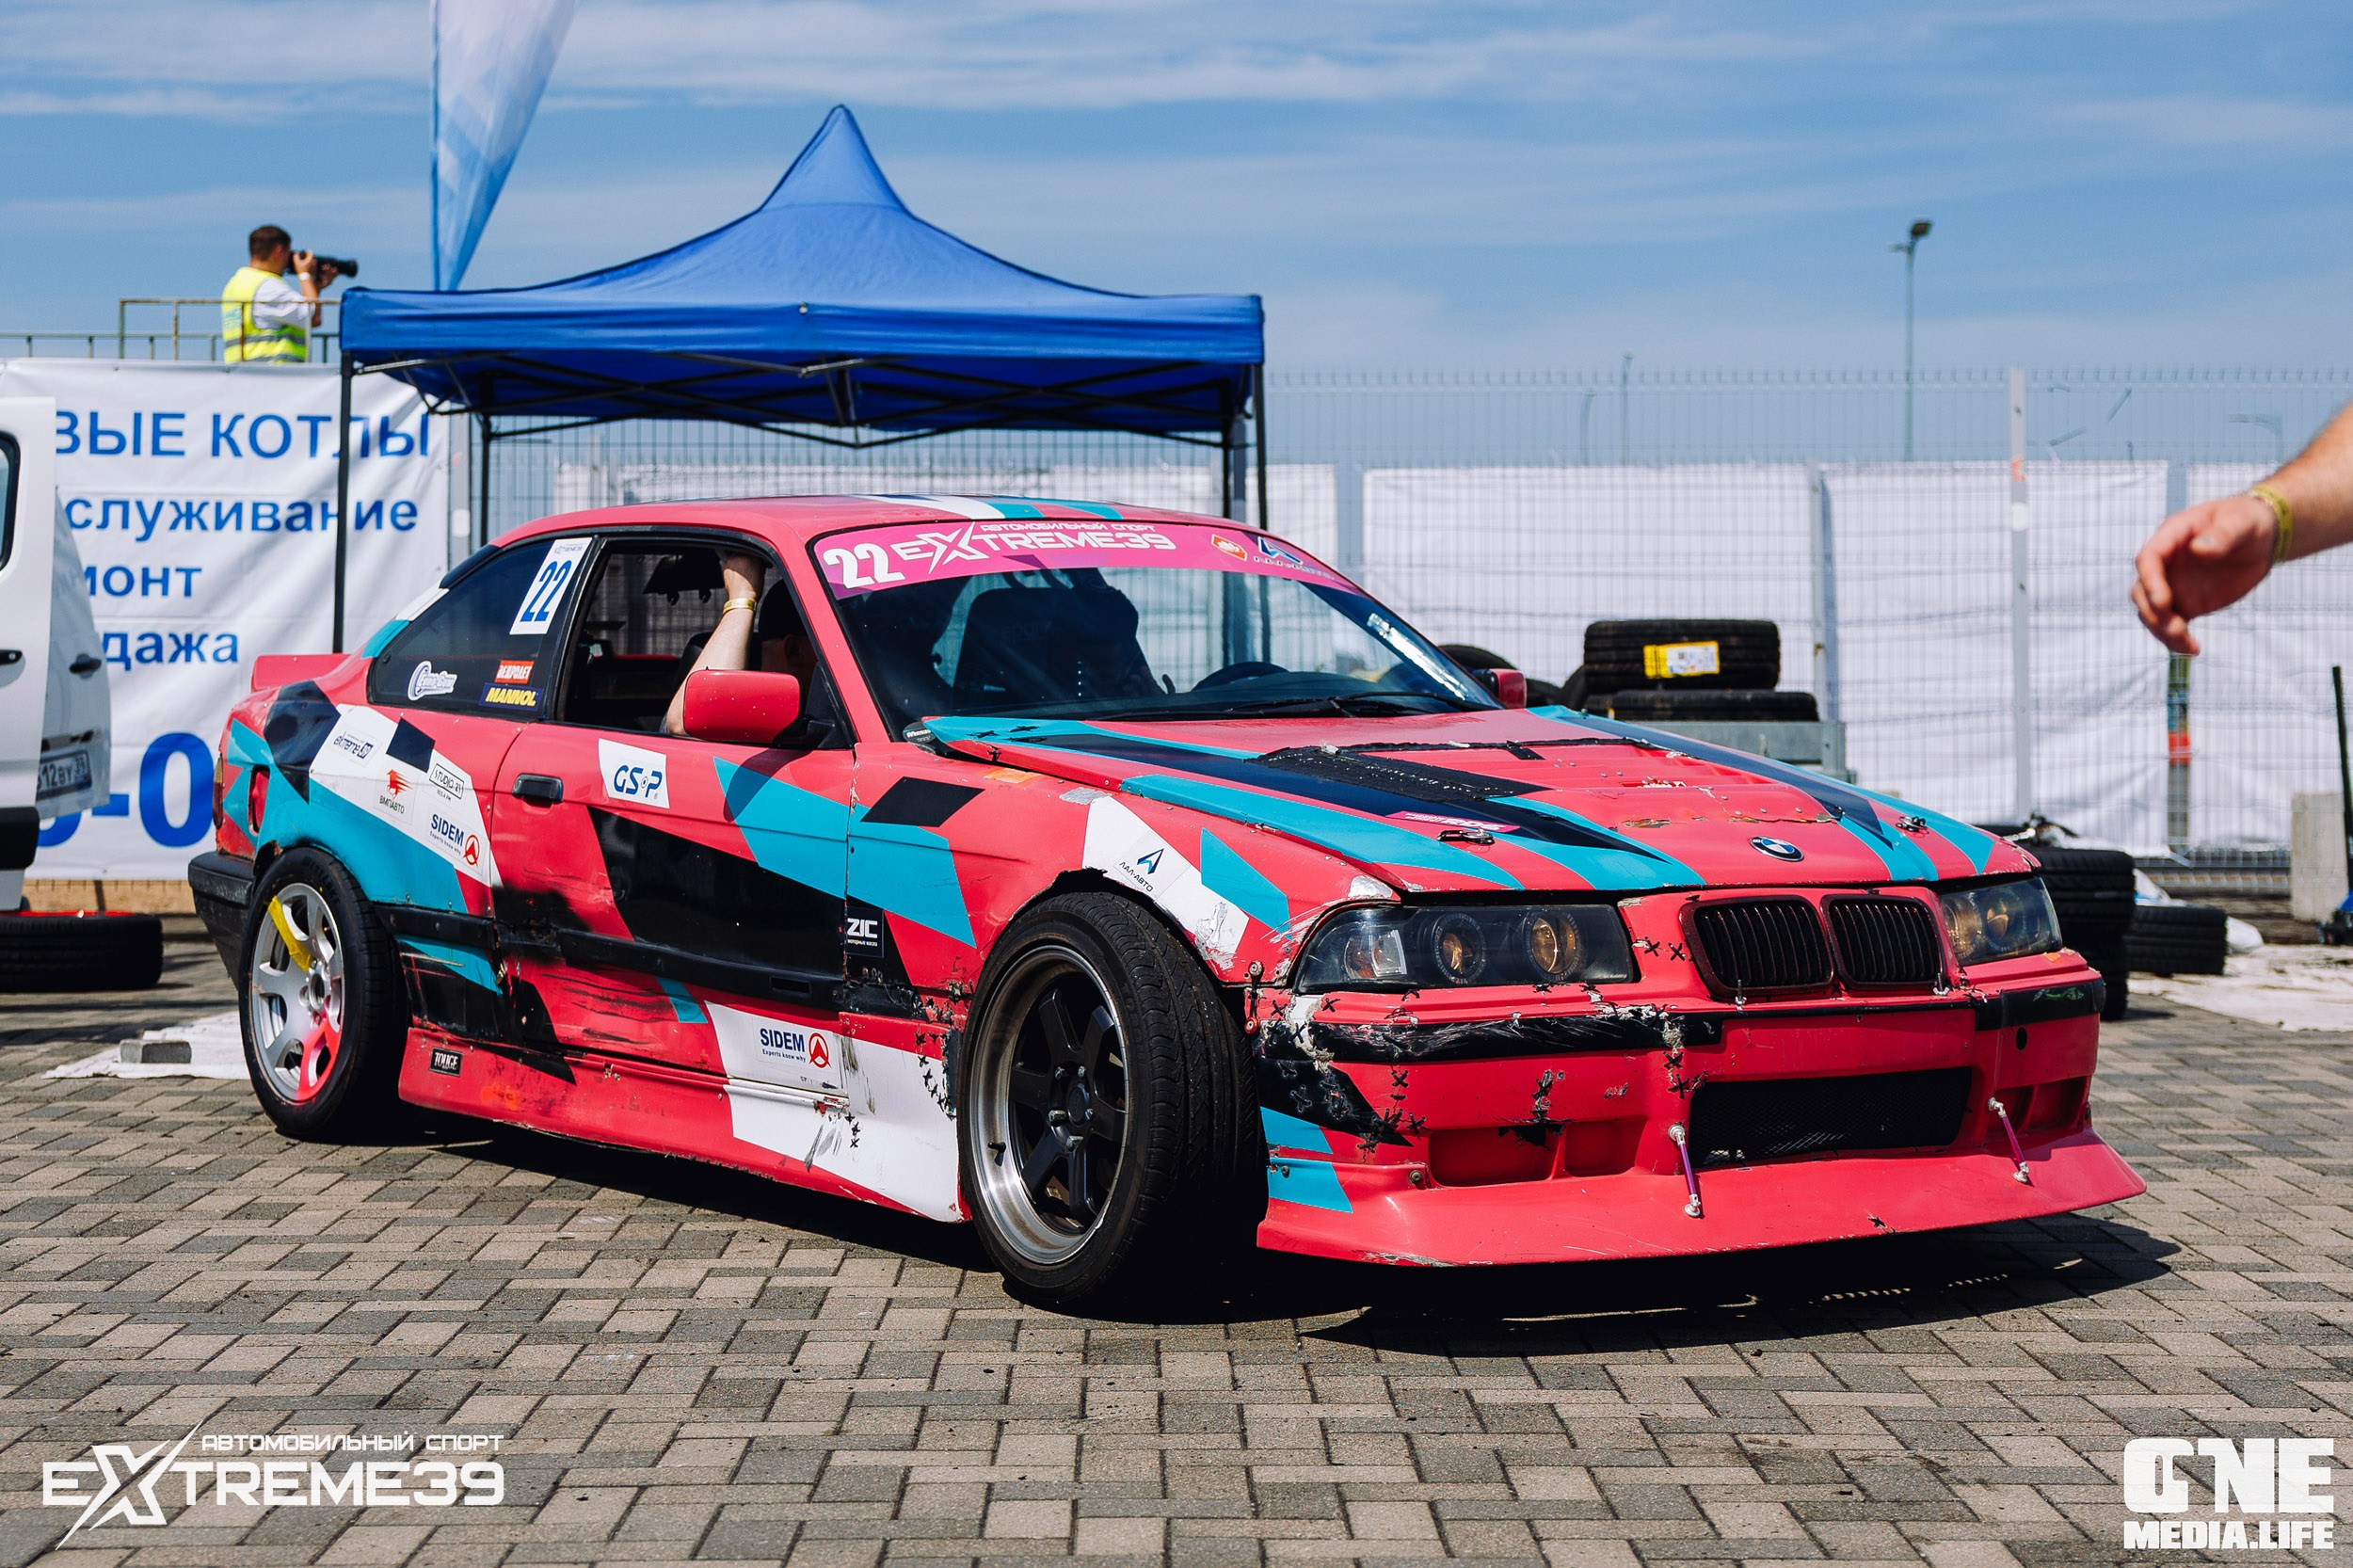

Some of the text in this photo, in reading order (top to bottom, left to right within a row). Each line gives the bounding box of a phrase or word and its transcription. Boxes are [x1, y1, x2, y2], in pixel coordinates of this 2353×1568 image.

[212, 414, 429, 459] КОТЛЫ
[980, 521, 1156, 532] АВТОМОБИЛЬНЫЙ СПОРТ
[823, 543, 905, 589] 22
[520, 560, 572, 622] 22
[485, 687, 536, 707] MANNOL
[435, 769, 454, 789] STUDIO
[431, 813, 464, 847] SIDEM
[847, 918, 878, 938] ZIC
[760, 1028, 805, 1052] SIDEM
[761, 1048, 781, 1058] Experts
[782, 1051, 794, 1060] know
